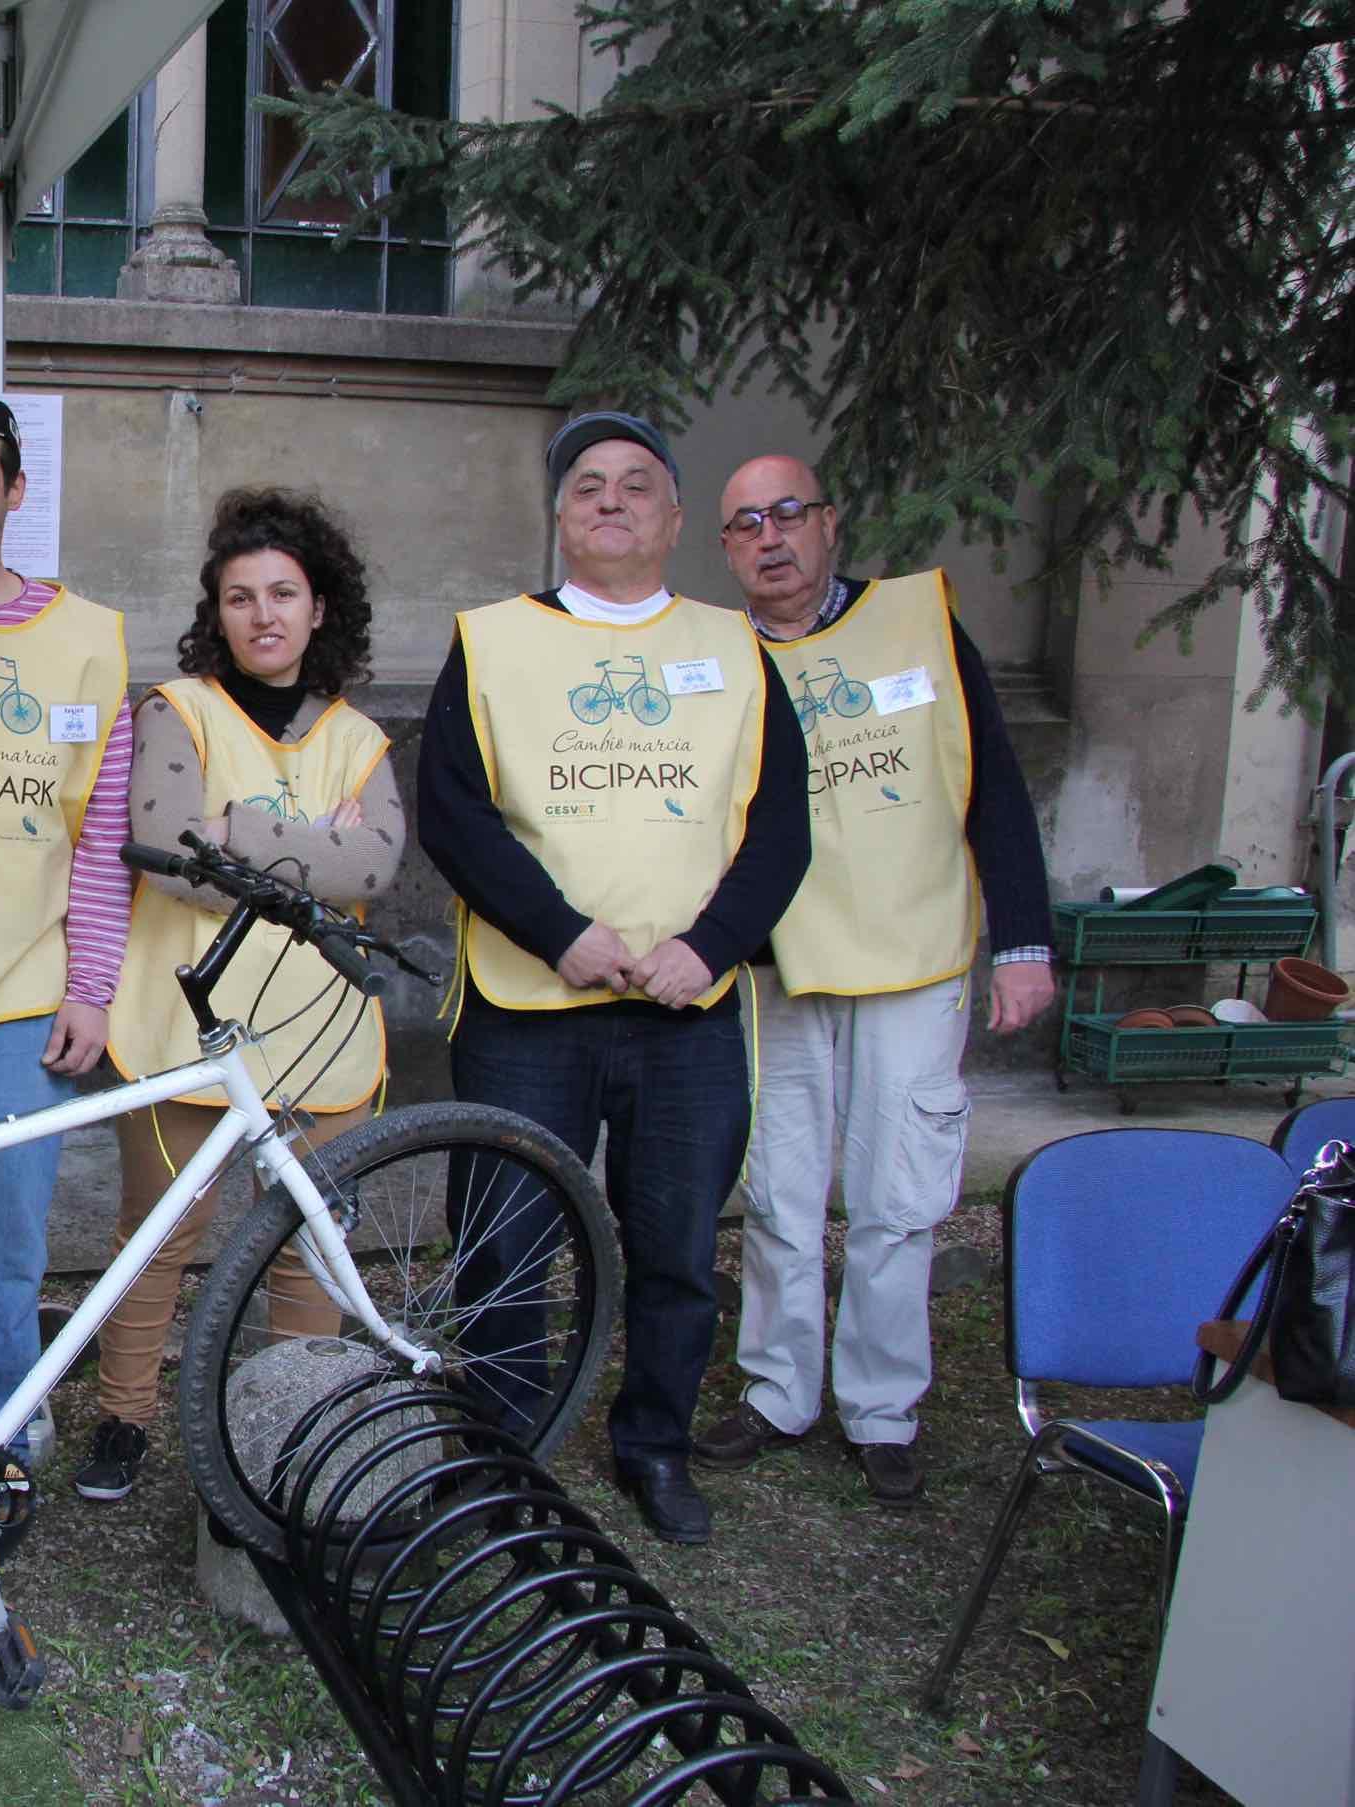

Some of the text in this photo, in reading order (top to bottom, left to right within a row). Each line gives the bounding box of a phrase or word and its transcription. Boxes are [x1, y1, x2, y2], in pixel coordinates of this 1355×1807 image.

[552, 728, 693, 753] Cambio marcia
[838, 725, 900, 747] marcia
[549, 763, 699, 790] BICIPARK
[808, 747, 910, 794] CIPARK
